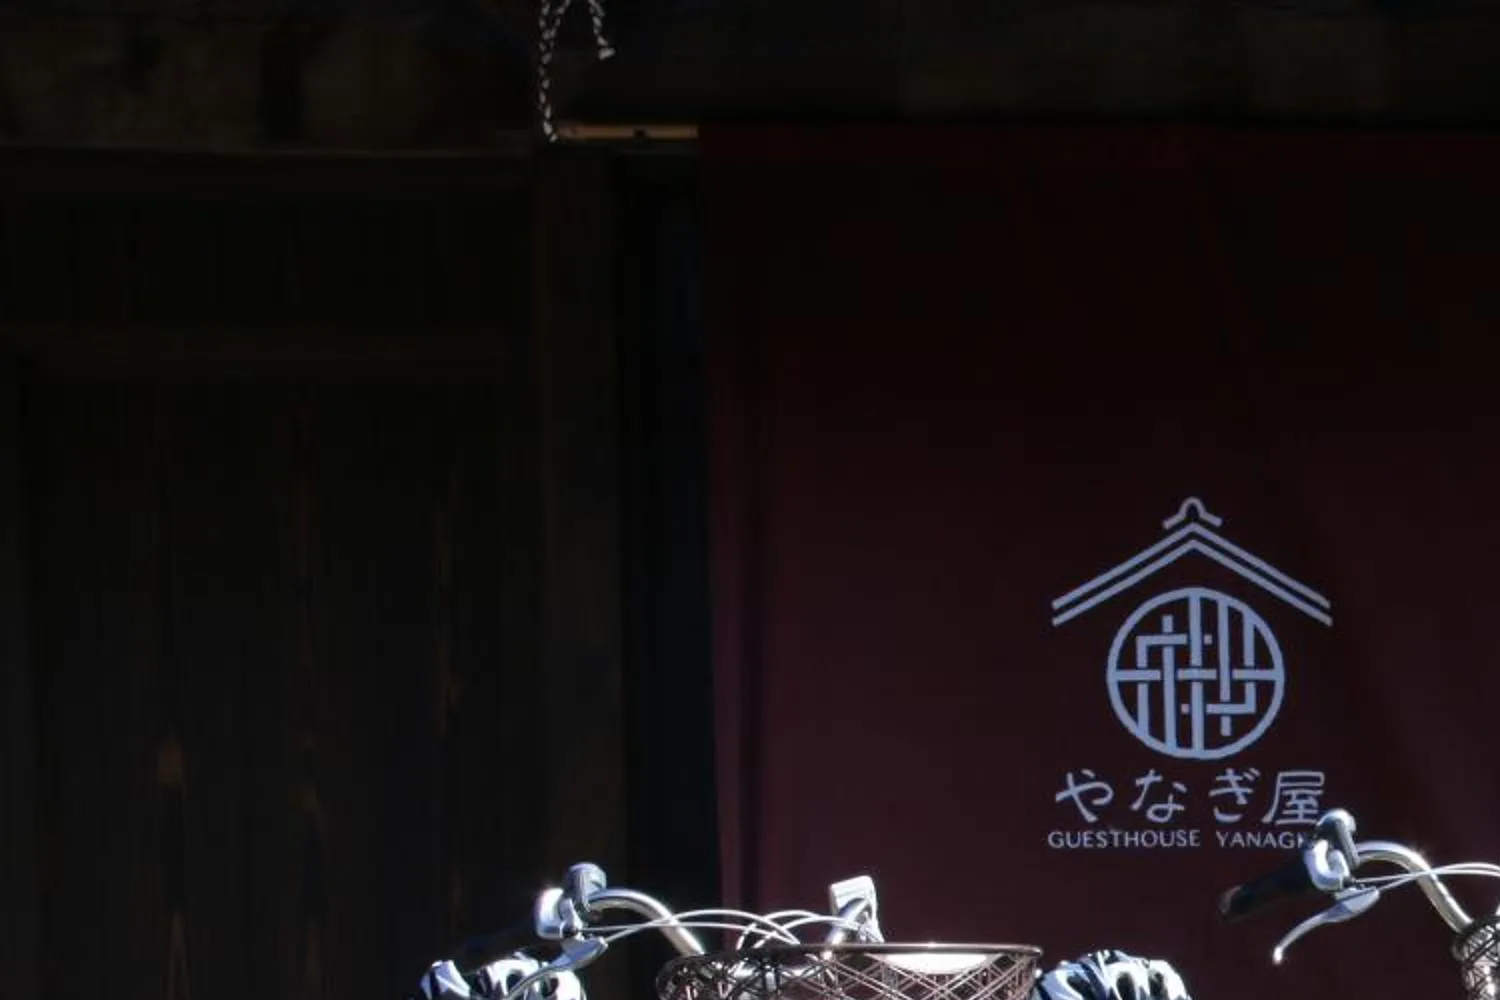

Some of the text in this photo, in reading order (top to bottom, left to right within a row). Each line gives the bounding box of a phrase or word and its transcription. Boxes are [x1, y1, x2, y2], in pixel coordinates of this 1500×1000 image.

[1055, 768, 1325, 825] やなぎ屋
[1048, 830, 1200, 849] GUESTHOUSE
